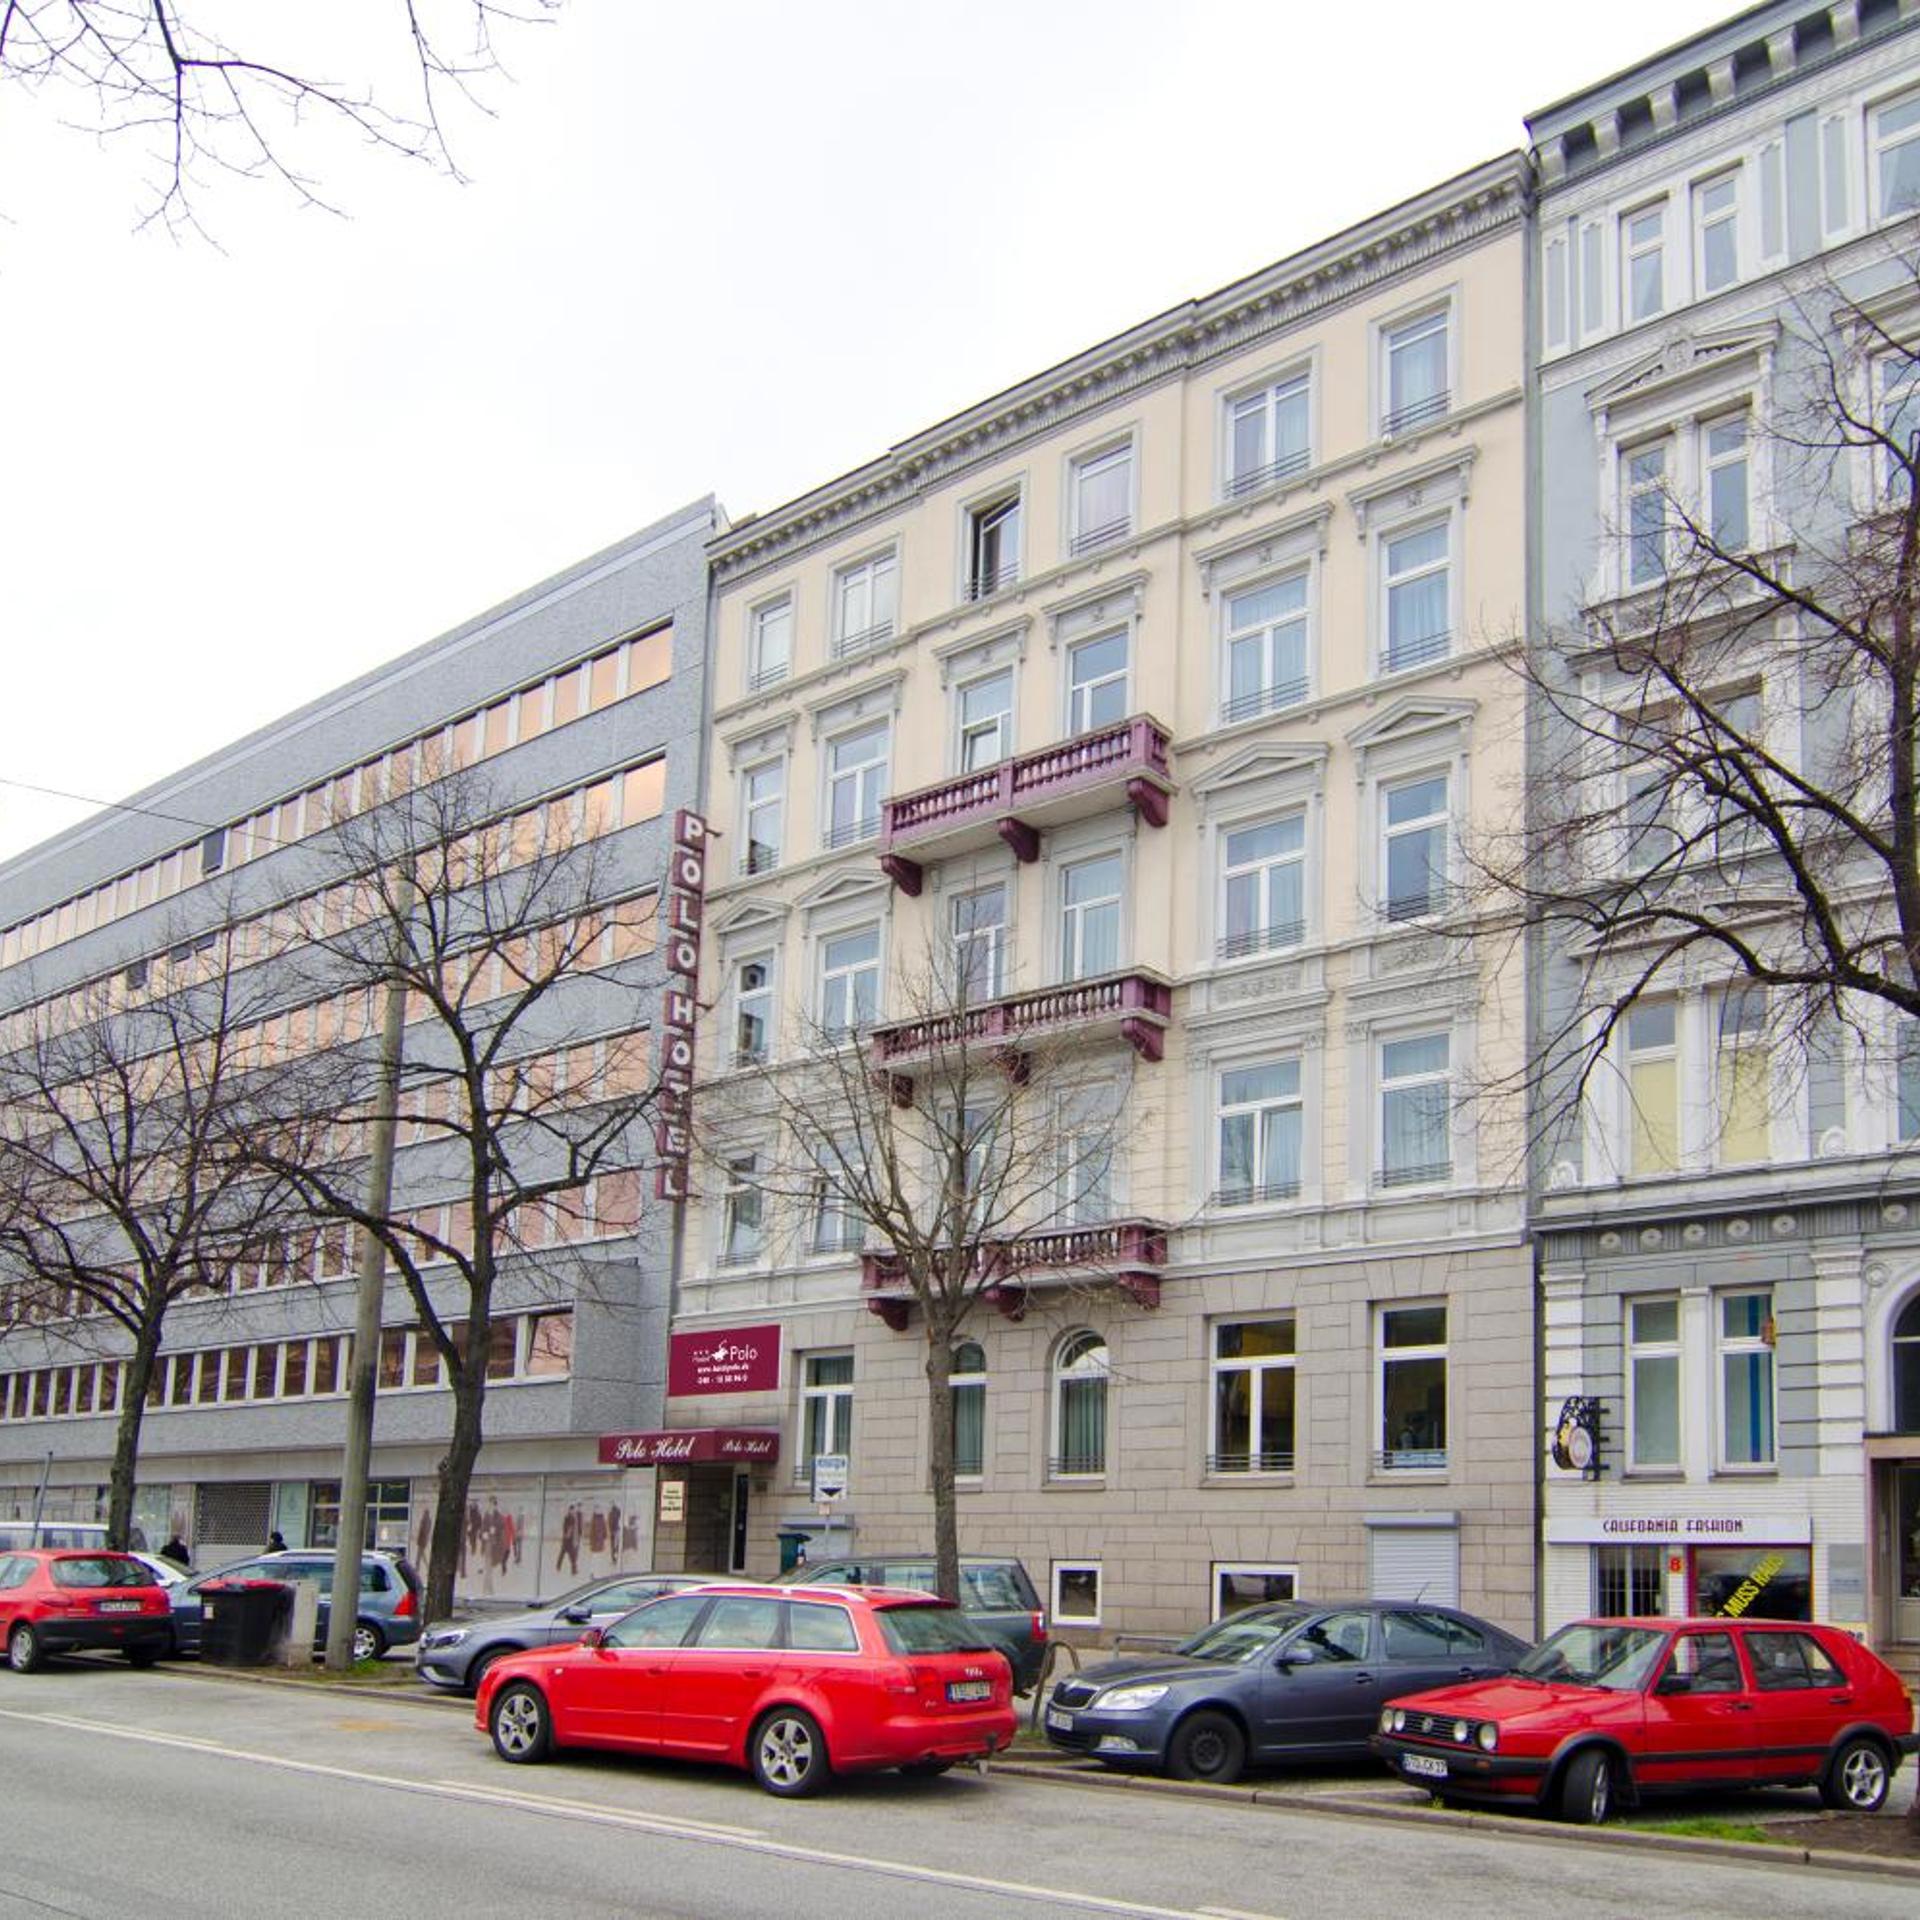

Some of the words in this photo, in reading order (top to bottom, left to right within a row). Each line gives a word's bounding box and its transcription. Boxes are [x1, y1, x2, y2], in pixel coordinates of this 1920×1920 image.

[675, 817, 704, 970] POLO
[729, 1344, 758, 1361] Polo
[616, 1438, 646, 1459] Polo
[650, 1436, 696, 1458] Hotel
[722, 1440, 742, 1453] Polo
[744, 1439, 772, 1453] Hotel
[1602, 1519, 1678, 1533] CALIFORNIA
[1686, 1519, 1743, 1533] FASHION
[1723, 1580, 1760, 1618] MUSS
